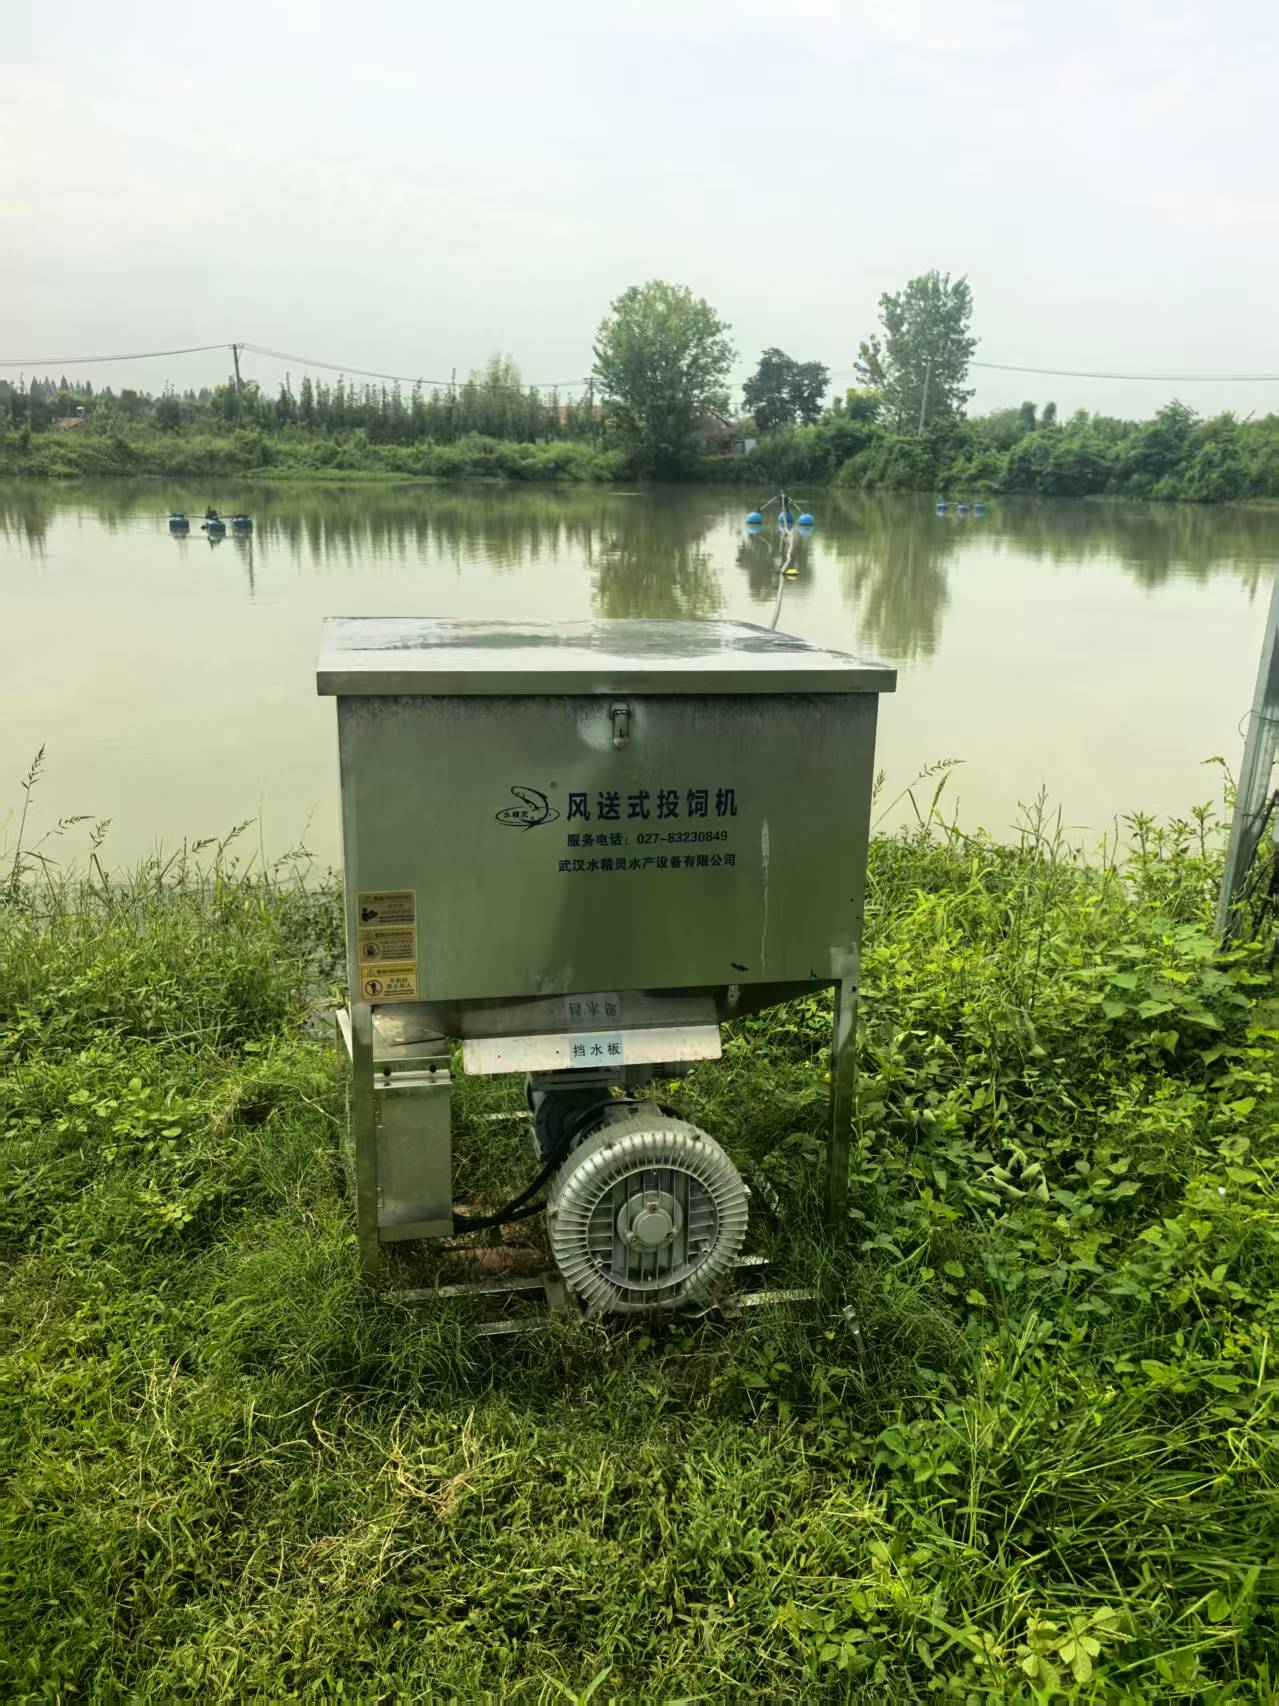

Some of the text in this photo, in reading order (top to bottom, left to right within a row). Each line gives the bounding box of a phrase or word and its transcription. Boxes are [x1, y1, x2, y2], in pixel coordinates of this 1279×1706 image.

[566, 788, 738, 822] 风送式投饲机
[558, 853, 737, 873] 武汉水精灵水产设备有限公司
[572, 1041, 621, 1058] 挡水板
